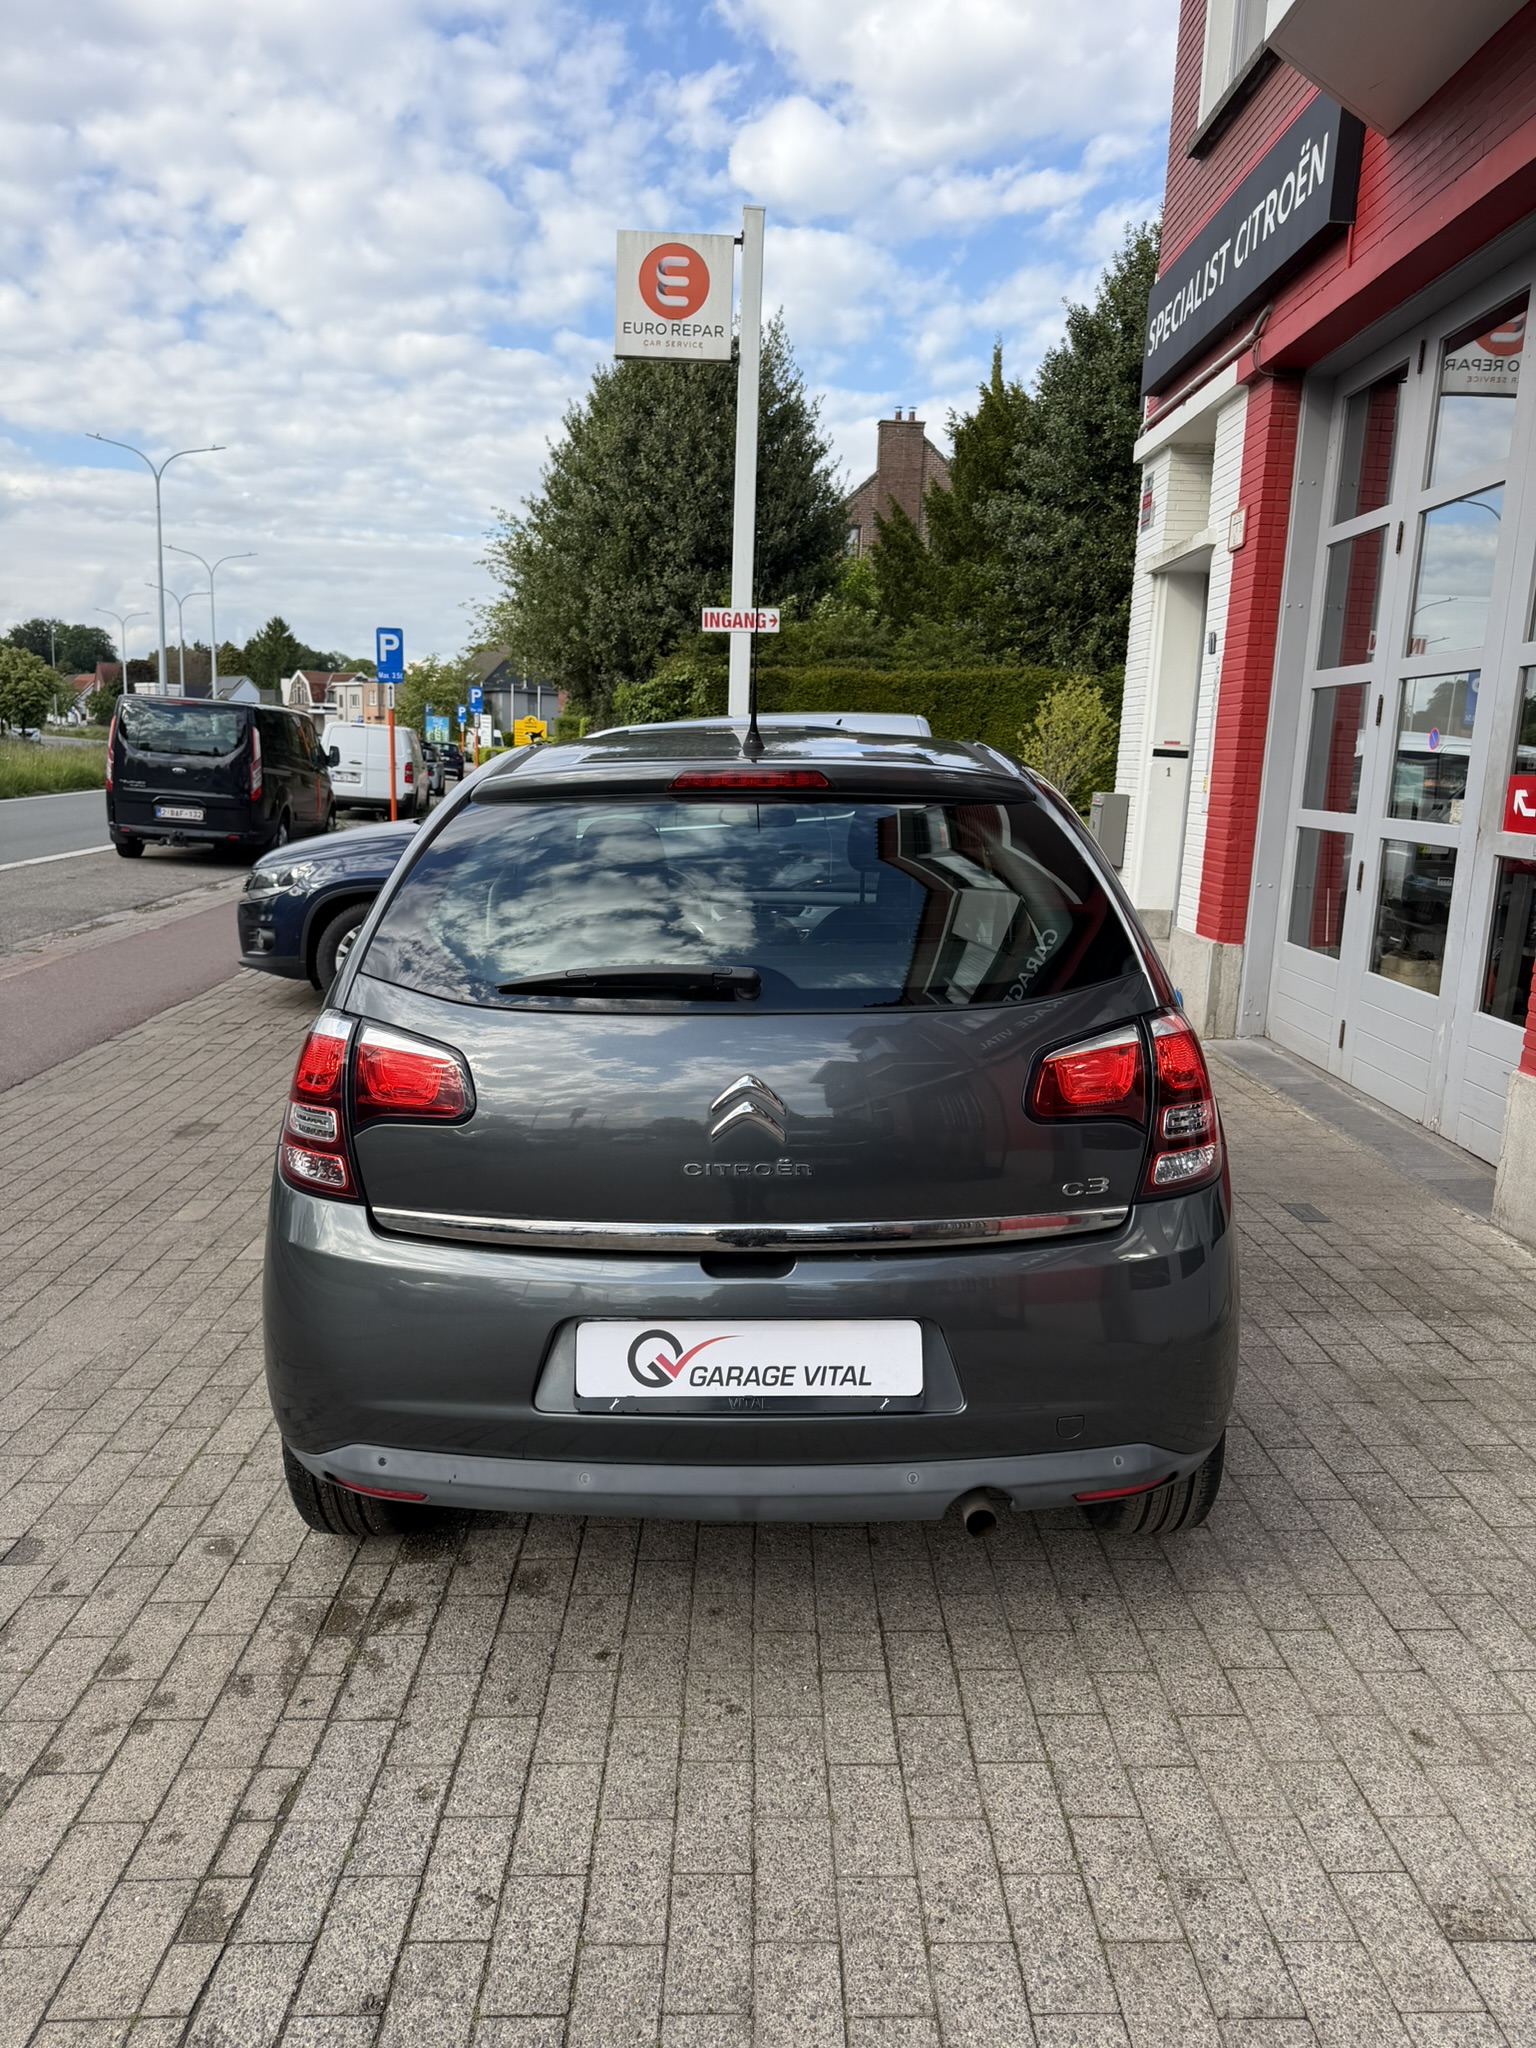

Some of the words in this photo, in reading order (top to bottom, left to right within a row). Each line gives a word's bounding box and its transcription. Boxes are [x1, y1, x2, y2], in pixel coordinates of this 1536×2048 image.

[1147, 238, 1231, 357] SPECIALIST
[1233, 131, 1329, 269] CITROËN
[622, 321, 667, 336] EURO
[671, 323, 724, 338] REPAR
[642, 339, 661, 347] CAR
[665, 340, 704, 349] SERVICE
[703, 612, 767, 629] INGANG
[380, 633, 400, 662] P
[471, 688, 482, 704] P
[458, 706, 467, 717] P
[1165, 767, 1171, 777] 1
[688, 1365, 797, 1387] GARAGE
[803, 1365, 873, 1387] VITAL
